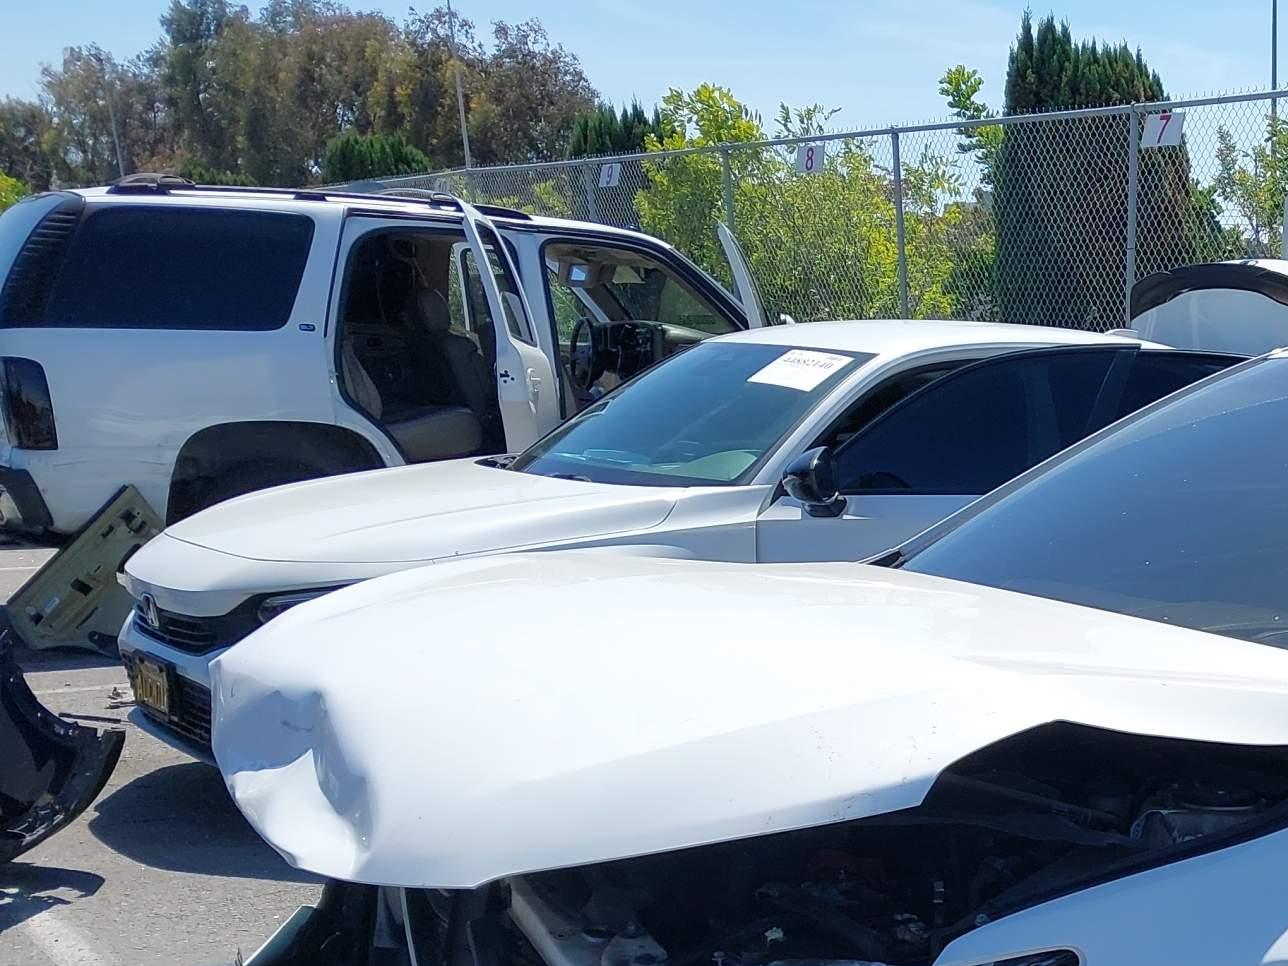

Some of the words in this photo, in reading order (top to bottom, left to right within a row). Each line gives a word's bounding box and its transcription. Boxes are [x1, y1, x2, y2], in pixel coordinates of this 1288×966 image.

[1157, 114, 1172, 144] 7
[805, 147, 814, 171] 8
[606, 165, 613, 185] 9
